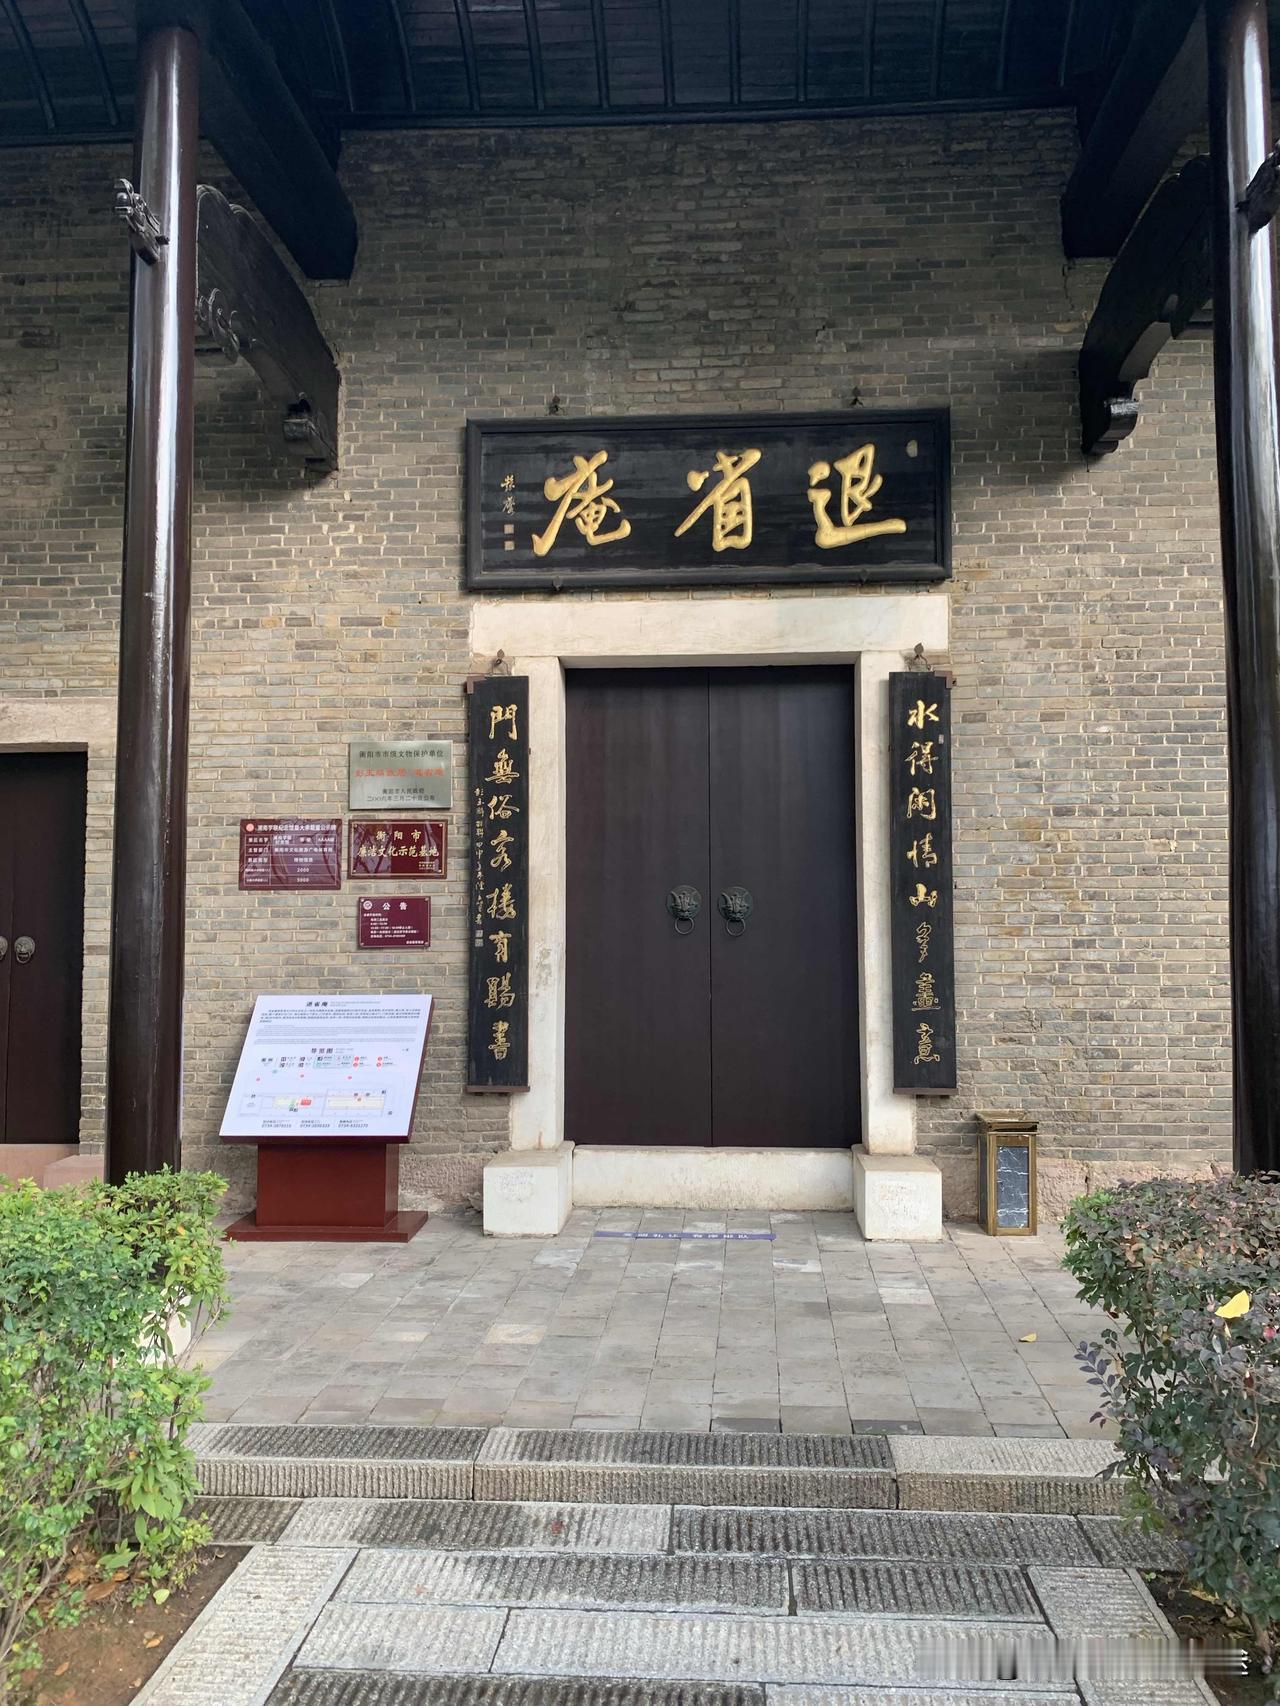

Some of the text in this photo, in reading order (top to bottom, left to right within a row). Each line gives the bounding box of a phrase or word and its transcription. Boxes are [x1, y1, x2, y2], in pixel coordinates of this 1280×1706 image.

[375, 829, 422, 842] 衡阳市
[357, 844, 440, 858] 廉洁文化示范基地
[382, 901, 408, 911] 公告
